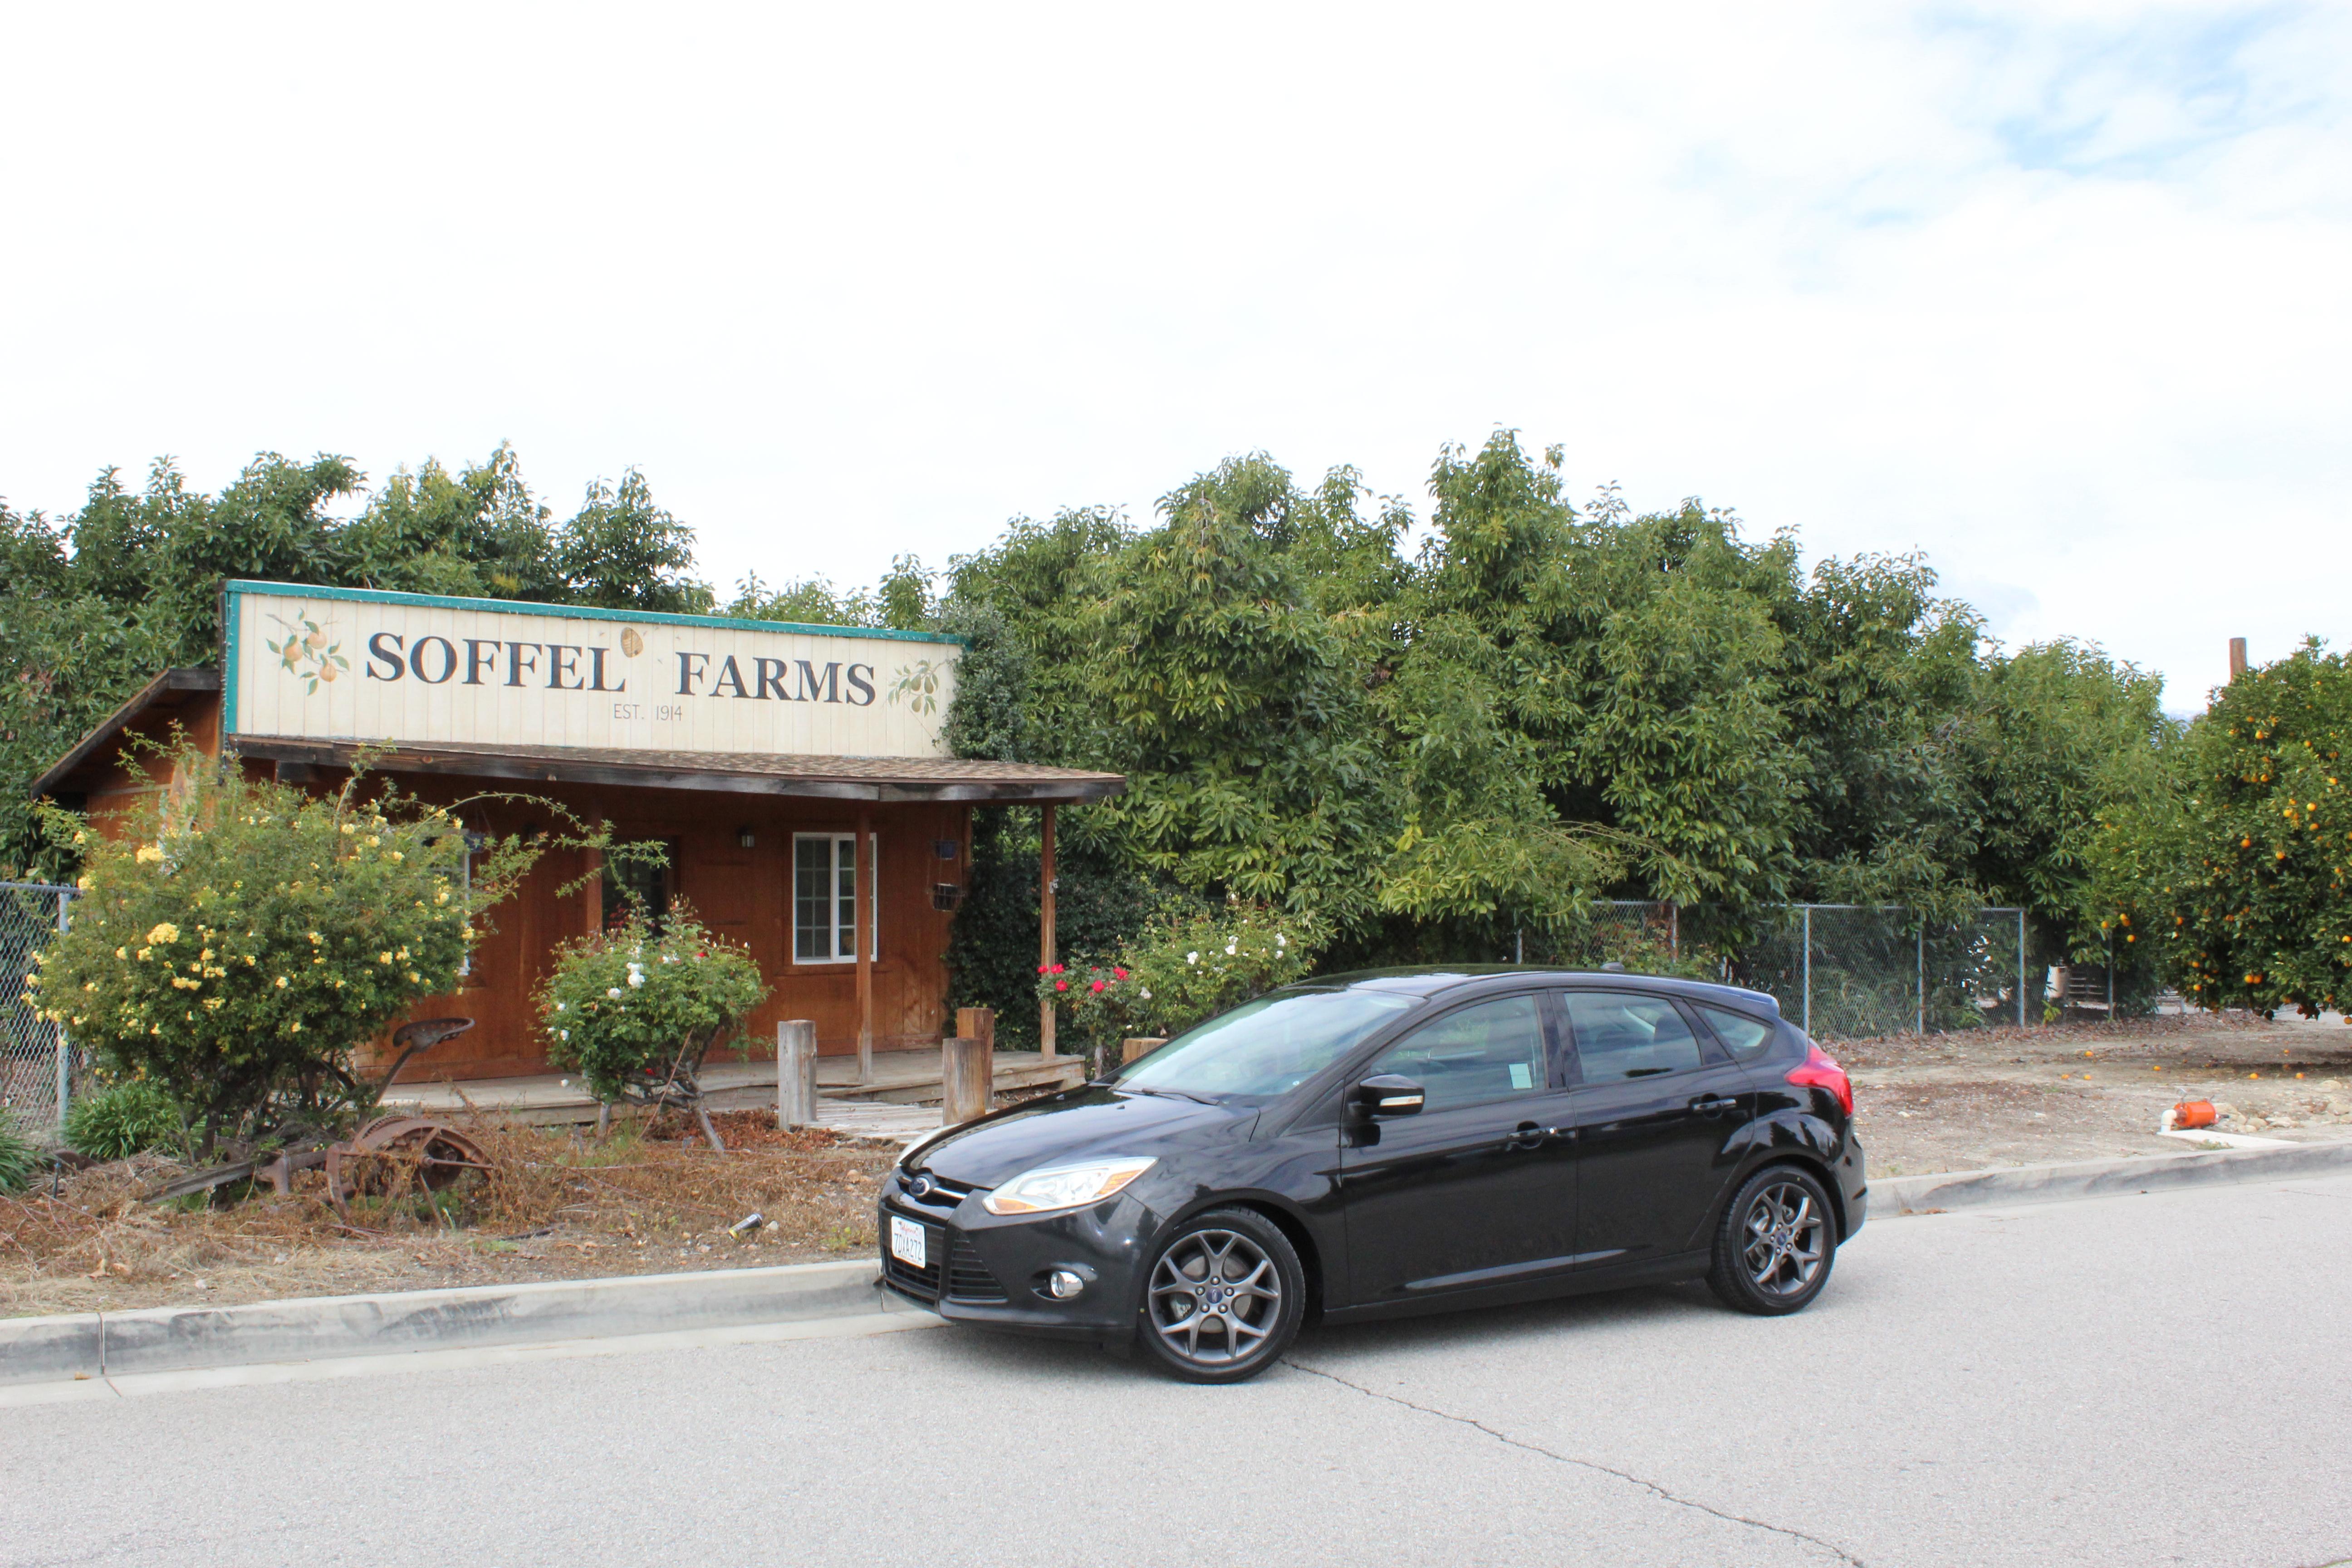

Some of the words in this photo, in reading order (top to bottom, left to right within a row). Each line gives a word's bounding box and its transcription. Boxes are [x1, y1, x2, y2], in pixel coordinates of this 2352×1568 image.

[367, 632, 626, 692] SOFFEL
[675, 652, 877, 706] FARMS
[614, 704, 644, 719] EST.
[656, 705, 682, 721] 1914
[894, 1233, 922, 1261] 7DXA272
